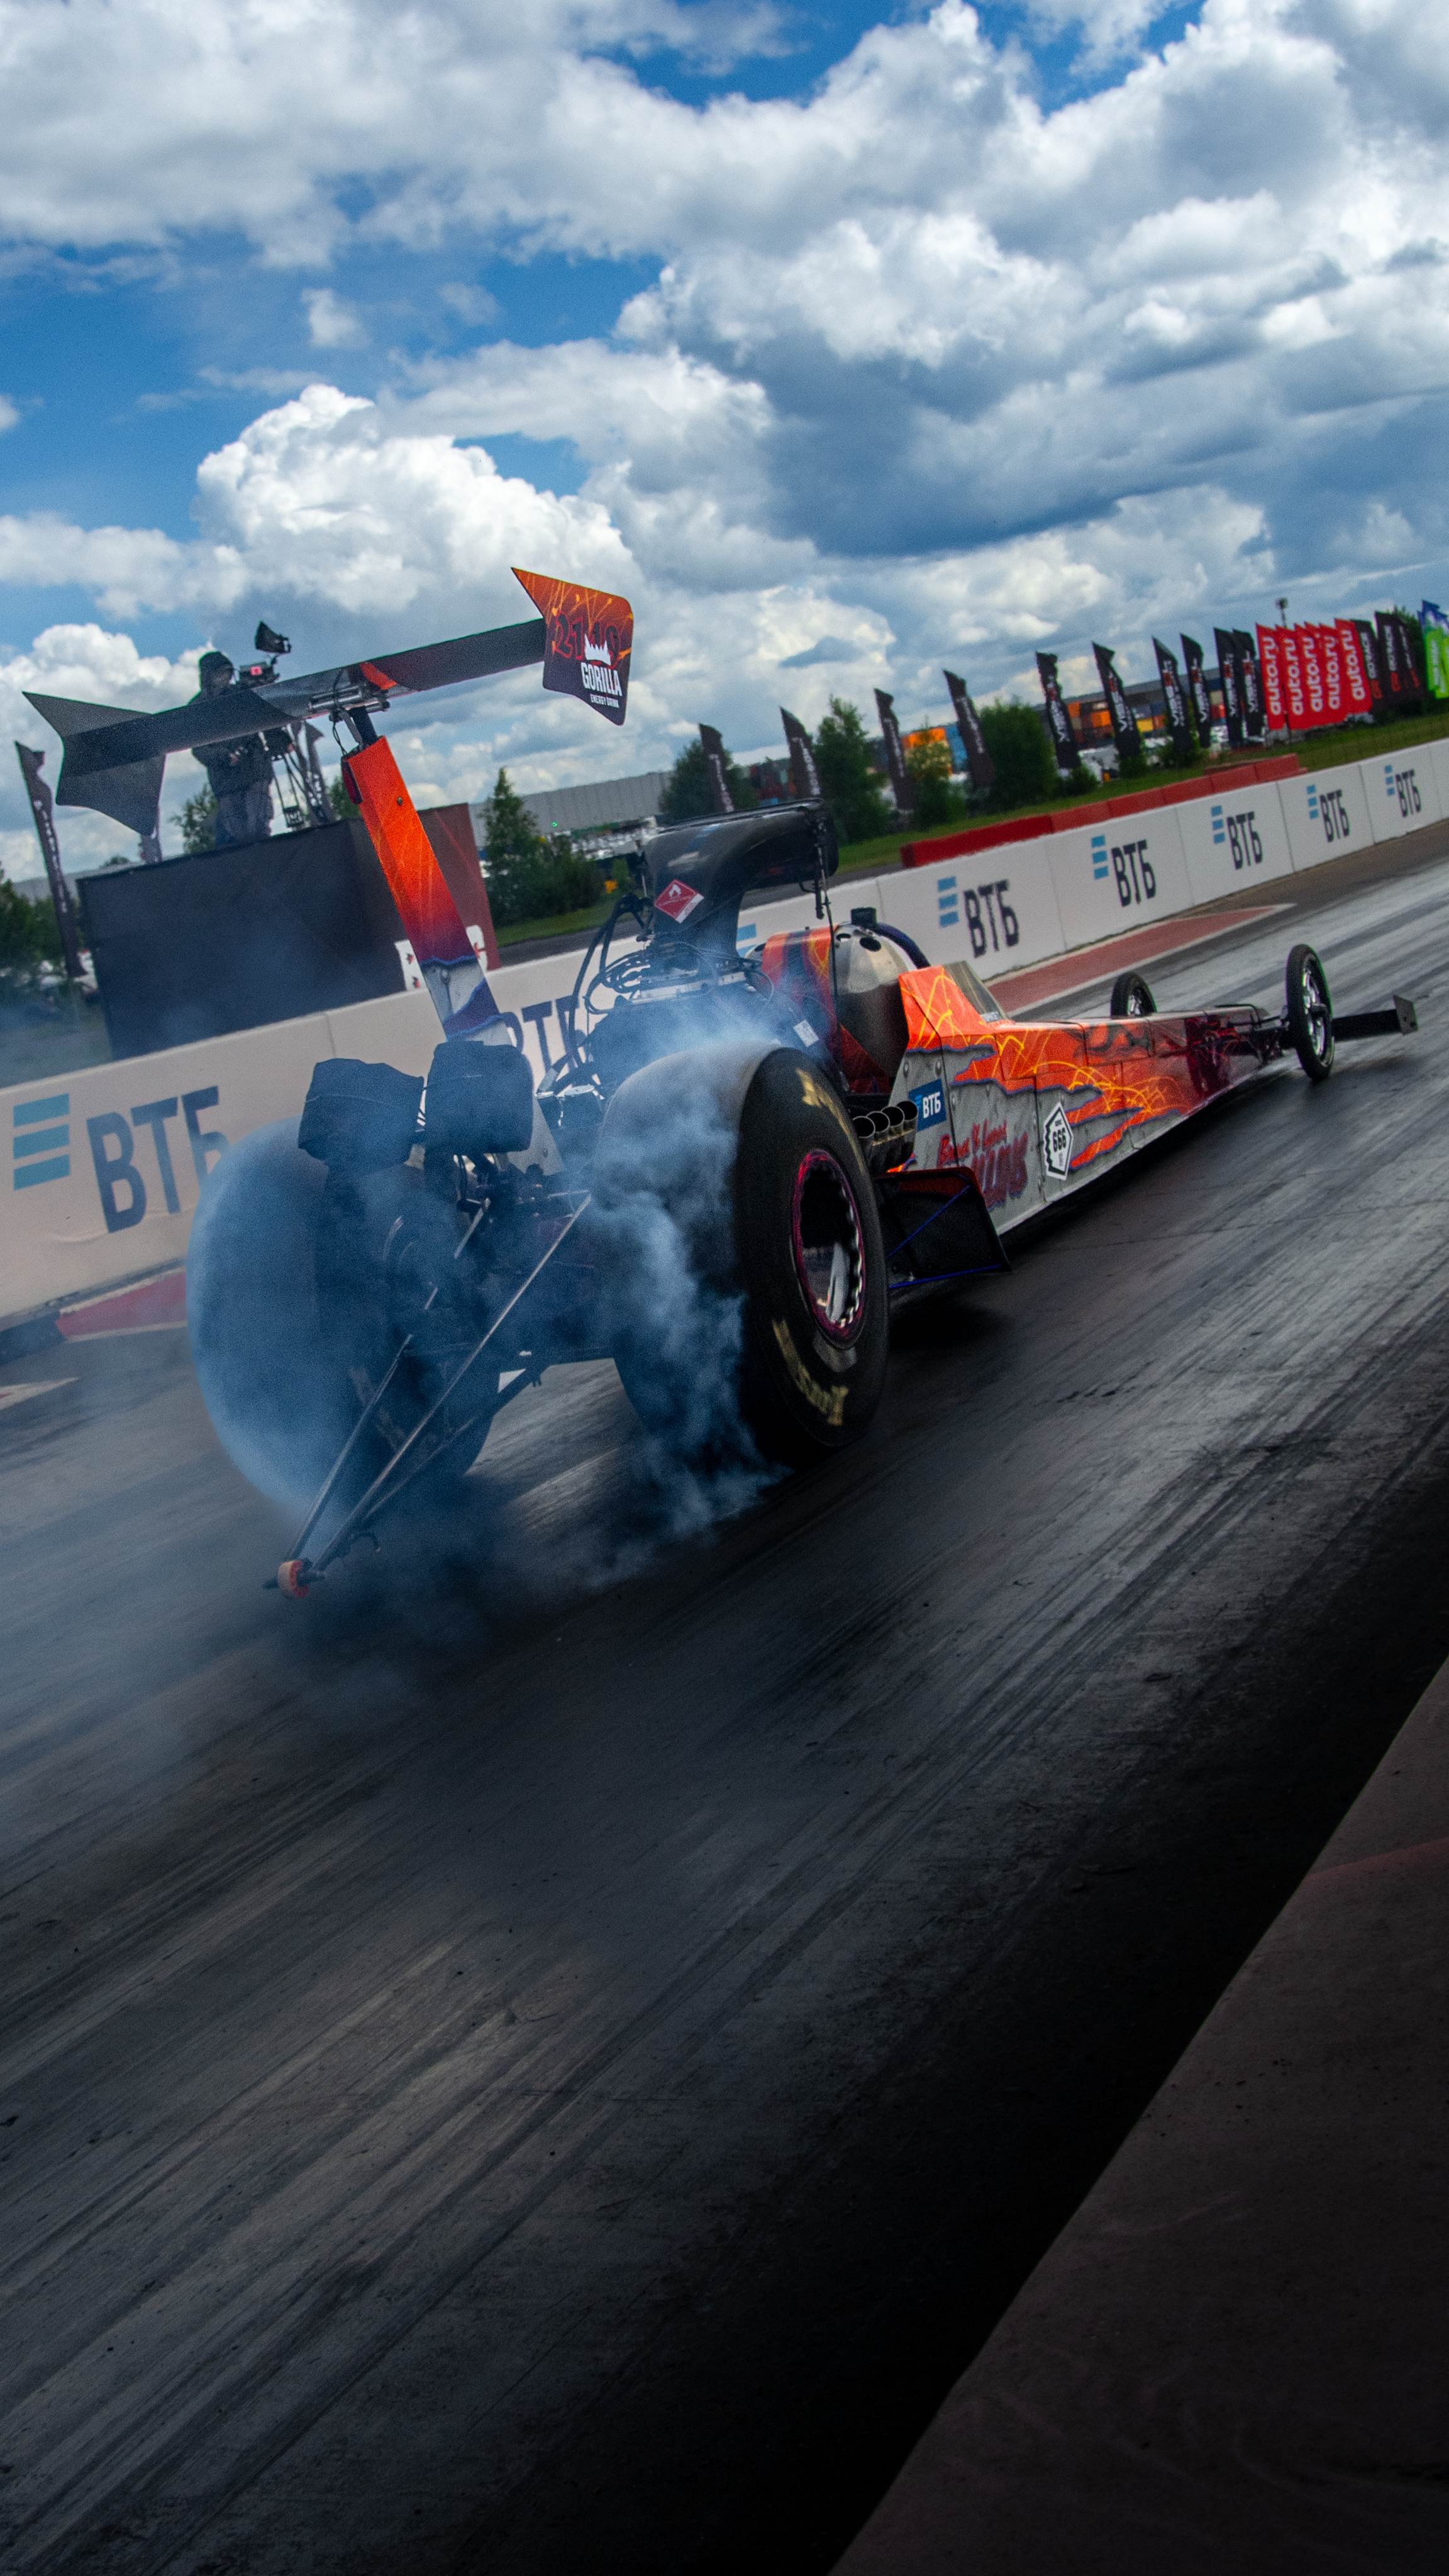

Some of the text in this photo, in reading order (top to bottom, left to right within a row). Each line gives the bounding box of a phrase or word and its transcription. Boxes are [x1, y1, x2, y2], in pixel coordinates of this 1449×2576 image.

[580, 662, 623, 696] GORILLA
[1262, 636, 1282, 716] auto.ru
[1284, 638, 1304, 716] auto.ru
[1302, 636, 1324, 712] auto.ru
[1324, 635, 1341, 710] auto.ru
[1341, 629, 1365, 701] auto.ru
[590, 694, 620, 709] ENERGY DRINK
[1319, 789, 1350, 843] ВТБ
[1395, 769, 1421, 818] ВТБ
[1226, 811, 1263, 870] ВТБ
[1111, 839, 1157, 908] ВТБ
[963, 879, 1020, 958] ВТБ
[923, 1092, 941, 1119] ВТБ
[1053, 1128, 1067, 1152] 666
